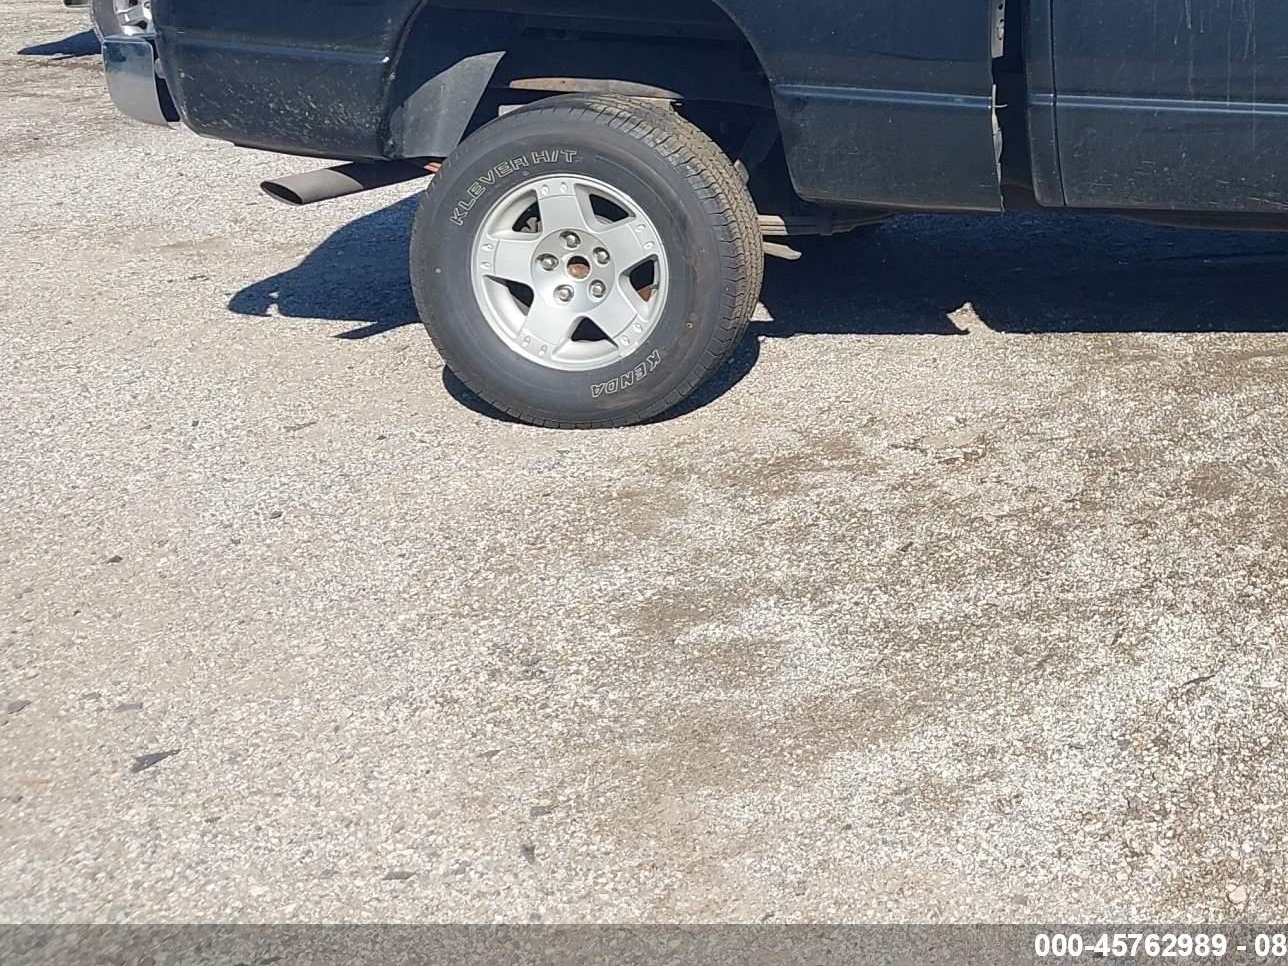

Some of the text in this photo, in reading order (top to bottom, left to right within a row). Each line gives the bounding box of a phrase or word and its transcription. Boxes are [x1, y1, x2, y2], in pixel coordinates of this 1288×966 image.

[450, 149, 577, 226] KLEVER H/T
[591, 348, 662, 398] KENDA
